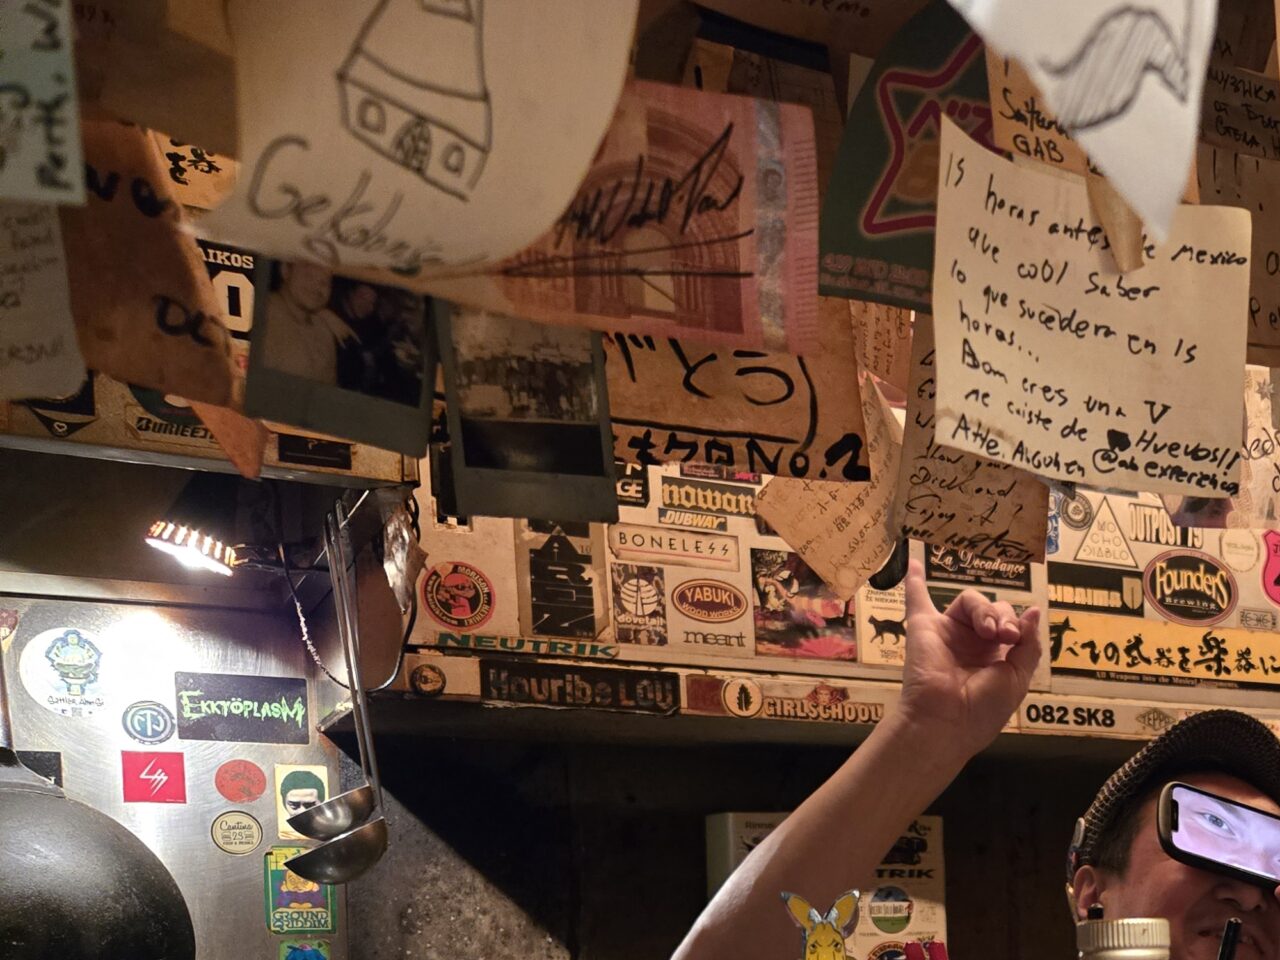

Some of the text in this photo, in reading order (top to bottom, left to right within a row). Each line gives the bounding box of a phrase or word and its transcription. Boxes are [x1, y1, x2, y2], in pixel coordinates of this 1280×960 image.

[1060, 418, 1088, 443] de
[661, 511, 725, 529] DUBWAY
[685, 588, 735, 606] YABUKI
[1155, 561, 1228, 609] Founders
[682, 602, 709, 617] WOOD
[438, 633, 616, 657] NEUTRIK
[683, 630, 746, 647] meant
[763, 695, 884, 723] GIRLSCHOOL
[1026, 704, 1116, 728] 082 SK8
